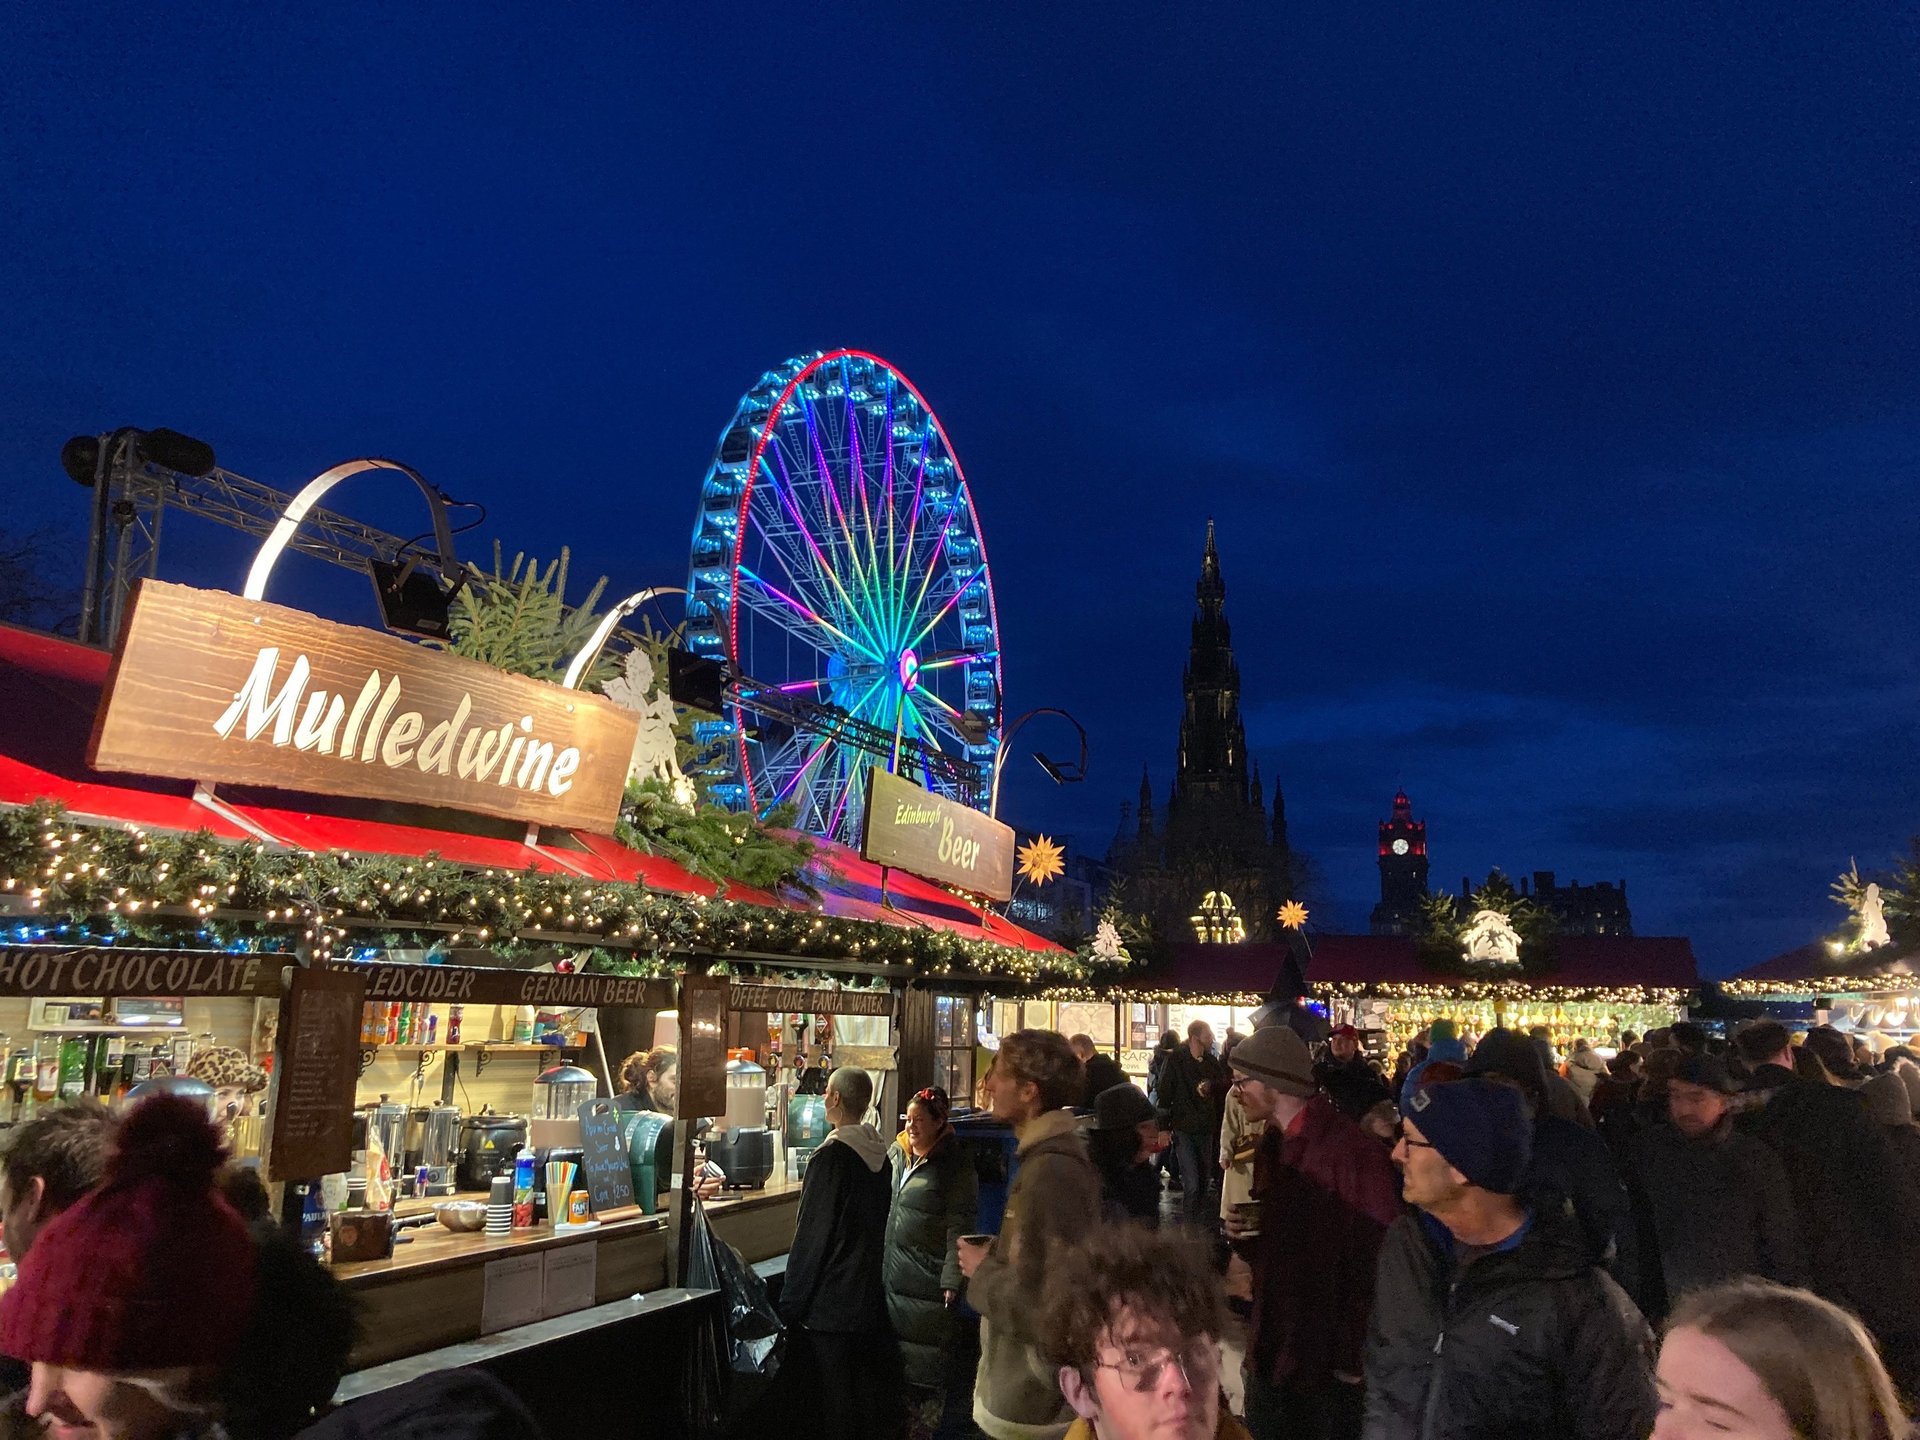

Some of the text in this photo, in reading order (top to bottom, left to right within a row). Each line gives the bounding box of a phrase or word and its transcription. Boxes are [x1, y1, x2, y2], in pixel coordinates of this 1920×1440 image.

[212, 647, 581, 797] Mulledwine
[895, 803, 941, 828] Edinburgh
[938, 816, 980, 871] Beer
[520, 975, 647, 1004] GERMAN BEER
[730, 986, 884, 1014] OFFEE COKE FANTA WATER
[1120, 1051, 1154, 1062] RARY
[302, 1211, 327, 1222] AULA
[572, 1202, 588, 1214] FAN
